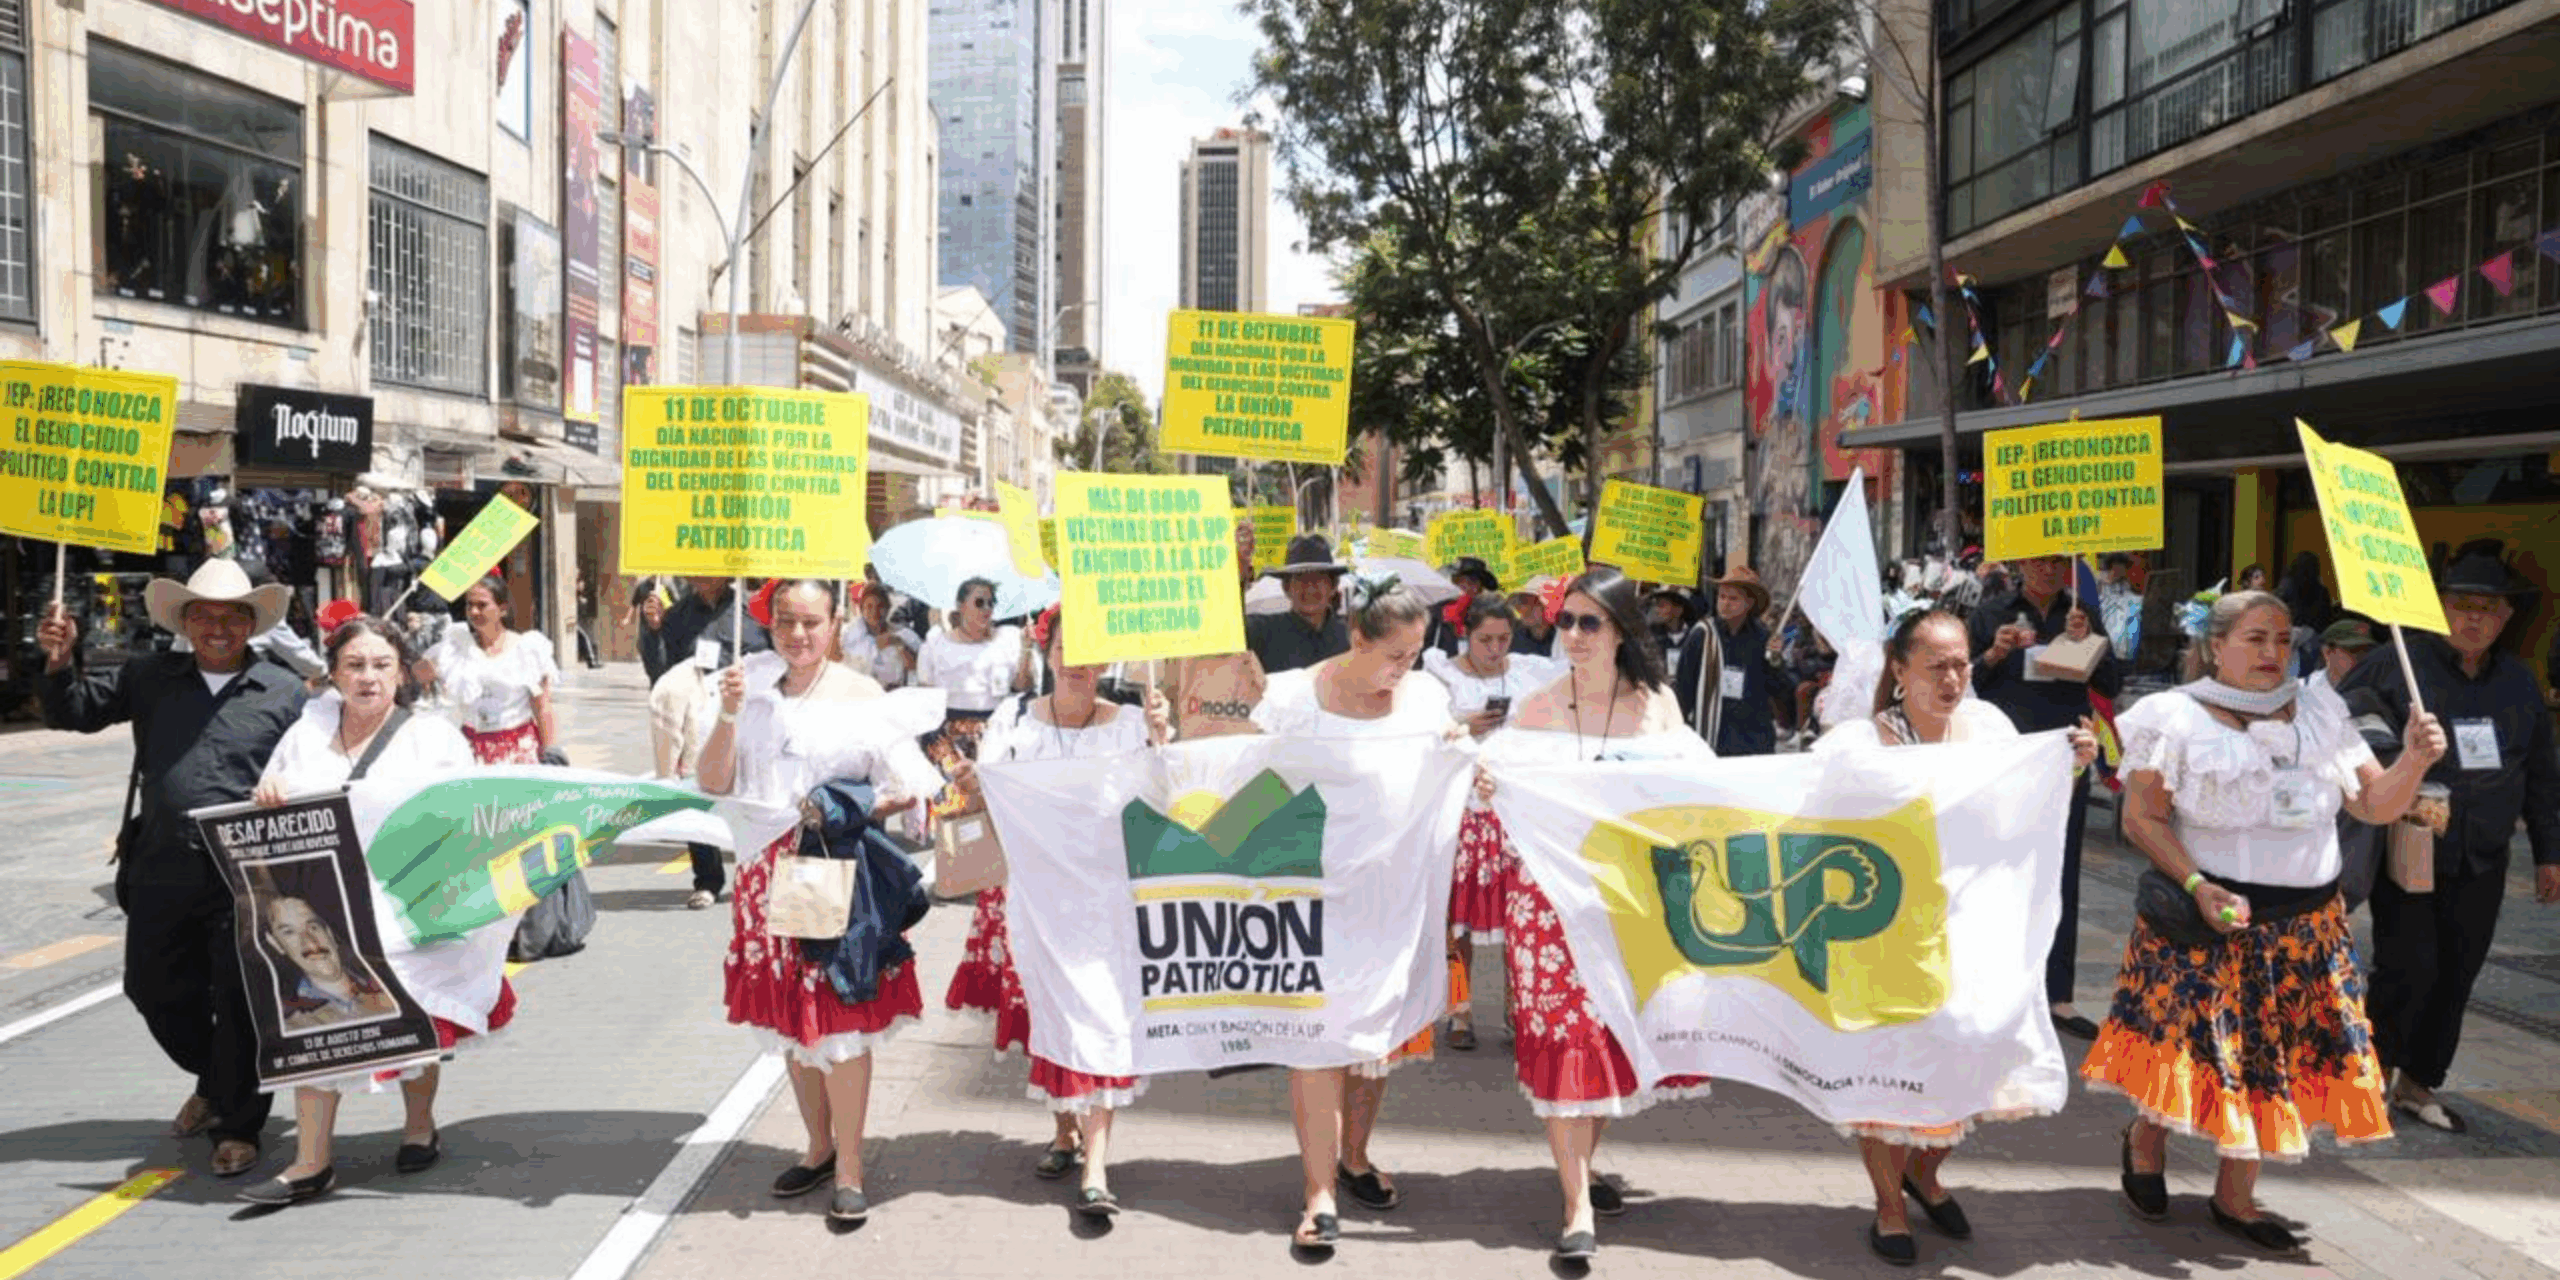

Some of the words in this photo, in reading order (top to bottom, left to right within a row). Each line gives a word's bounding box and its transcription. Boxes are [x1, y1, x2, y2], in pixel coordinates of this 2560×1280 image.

[1218, 320, 1239, 339] DE
[1242, 321, 1322, 344] OCTUBRE
[37, 385, 161, 423] ¡RECONOZCA
[664, 396, 685, 422] 11
[691, 397, 716, 423] DE
[722, 397, 826, 426] OCTUBRE
[1216, 395, 1235, 413] LA
[15, 416, 30, 445] EL
[35, 419, 140, 456] GENOCIDIO
[690, 426, 768, 447] NACIONAL
[772, 429, 808, 449] POR
[812, 432, 832, 451] LA
[2033, 432, 2152, 464] ¡RECONOZCA
[630, 449, 712, 469] DIGNIDAD
[715, 450, 734, 469] DE
[738, 450, 768, 470] LAS
[75, 458, 157, 494] CONTRA
[646, 472, 674, 491] DEL
[678, 473, 768, 492] GENOCIDIO
[771, 474, 842, 496] CONTRA
[2011, 470, 2027, 490] EL
[2033, 461, 2136, 488] GENOCIDIO
[39, 488, 57, 516] LA
[59, 492, 95, 522] UP!
[692, 494, 716, 519] LA
[721, 492, 792, 521] UNIÓN
[1126, 487, 1146, 515] DE
[2077, 486, 2156, 510] CONTRA
[676, 521, 806, 551] PATRIÓTICA
[1151, 518, 1171, 543] DE
[1176, 517, 1200, 543] LA
[1203, 516, 1229, 544] UP
[2042, 517, 2063, 538] LA
[1072, 547, 1151, 575] EXIGIMOS
[1154, 548, 1165, 573] A
[1170, 547, 1194, 573] LA
[1199, 544, 1229, 571] JEP
[1097, 576, 1183, 606] DECLARAR
[1187, 574, 1206, 601] EL
[1107, 605, 1201, 636] GENOCIDIO
[1187, 695, 1250, 719] Dmoda
[216, 807, 337, 847] DESAPARECIDO
[1650, 832, 1903, 995] UP
[1141, 952, 1324, 997] PATRIÓTICA
[1276, 1021, 1289, 1036] DE
[1292, 1022, 1304, 1037] LA
[1307, 1023, 1325, 1038] UP
[1221, 1038, 1252, 1053] 1985
[1691, 1030, 1703, 1043] EL
[1707, 1030, 1760, 1052] CAMINO
[1782, 1057, 1853, 1091] DEMOCRACIA
[1857, 1074, 1865, 1086] Y
[1868, 1074, 1879, 1086] A
[1881, 1075, 1898, 1088] LA
[1899, 1078, 1924, 1095] PAZ
